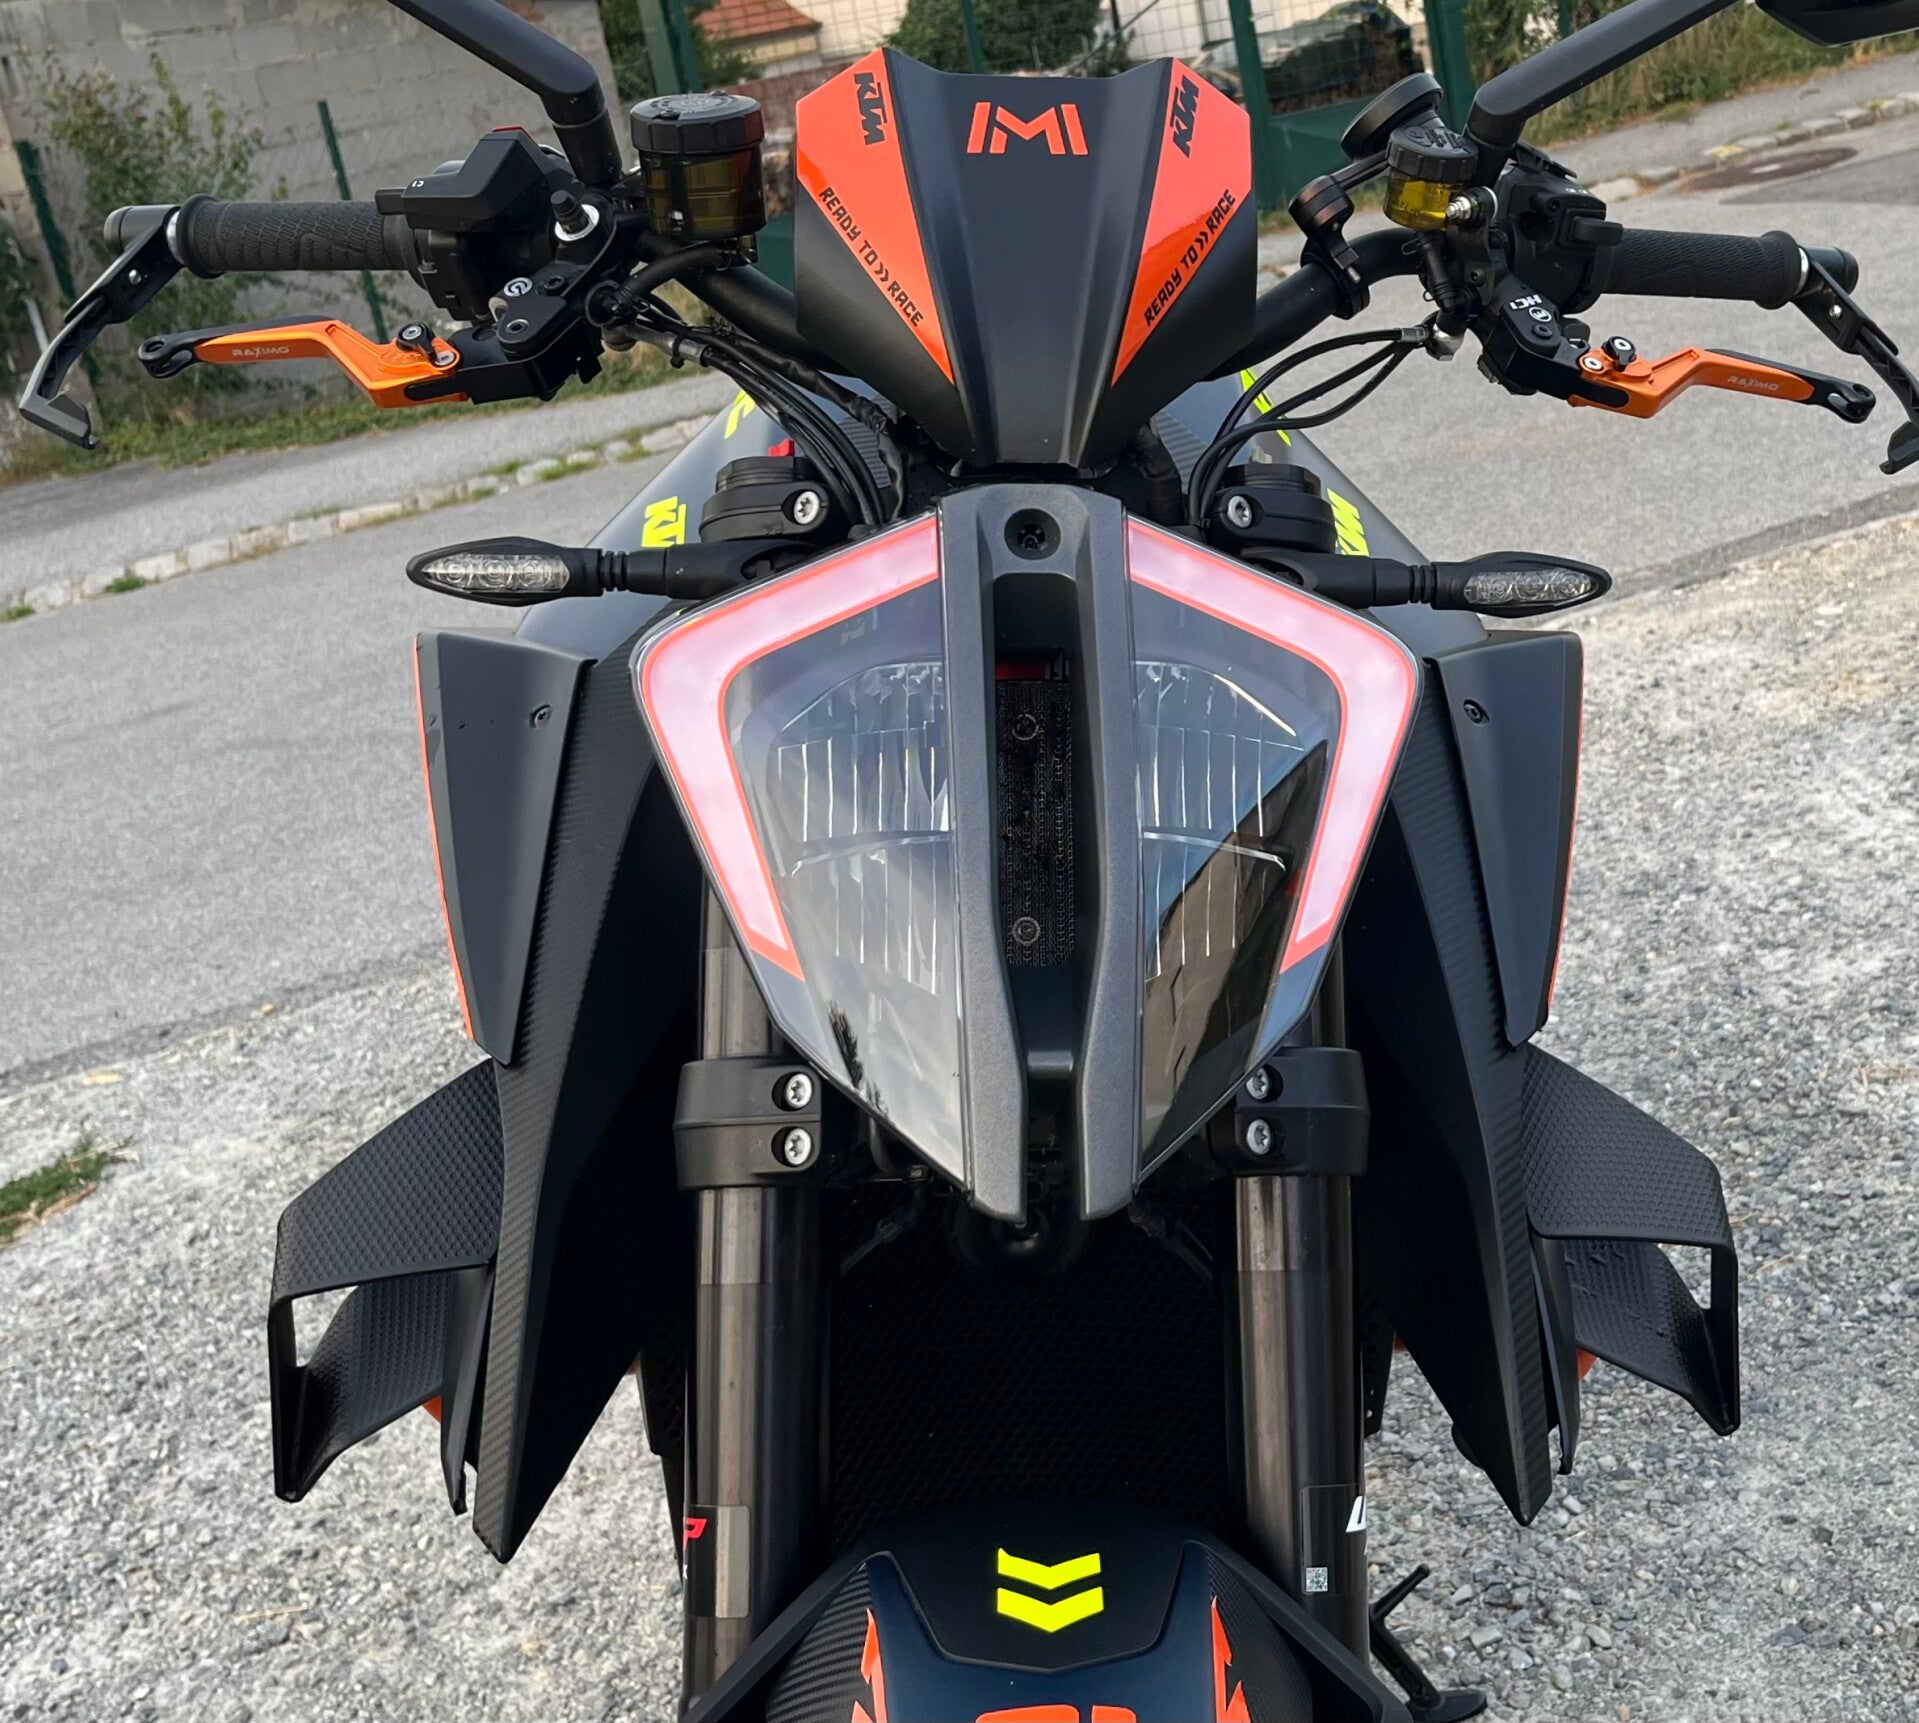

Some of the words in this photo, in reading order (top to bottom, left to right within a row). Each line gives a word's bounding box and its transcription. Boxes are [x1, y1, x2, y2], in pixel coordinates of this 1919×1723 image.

[854, 72, 887, 145] KTM
[1170, 75, 1200, 158] KTM
[819, 187, 862, 242] READY
[859, 239, 879, 266] TO
[887, 280, 924, 327] RACE
[1144, 268, 1183, 327] READY
[1181, 245, 1199, 269] TO
[1205, 189, 1236, 235] RACE
[641, 495, 687, 548] KT
